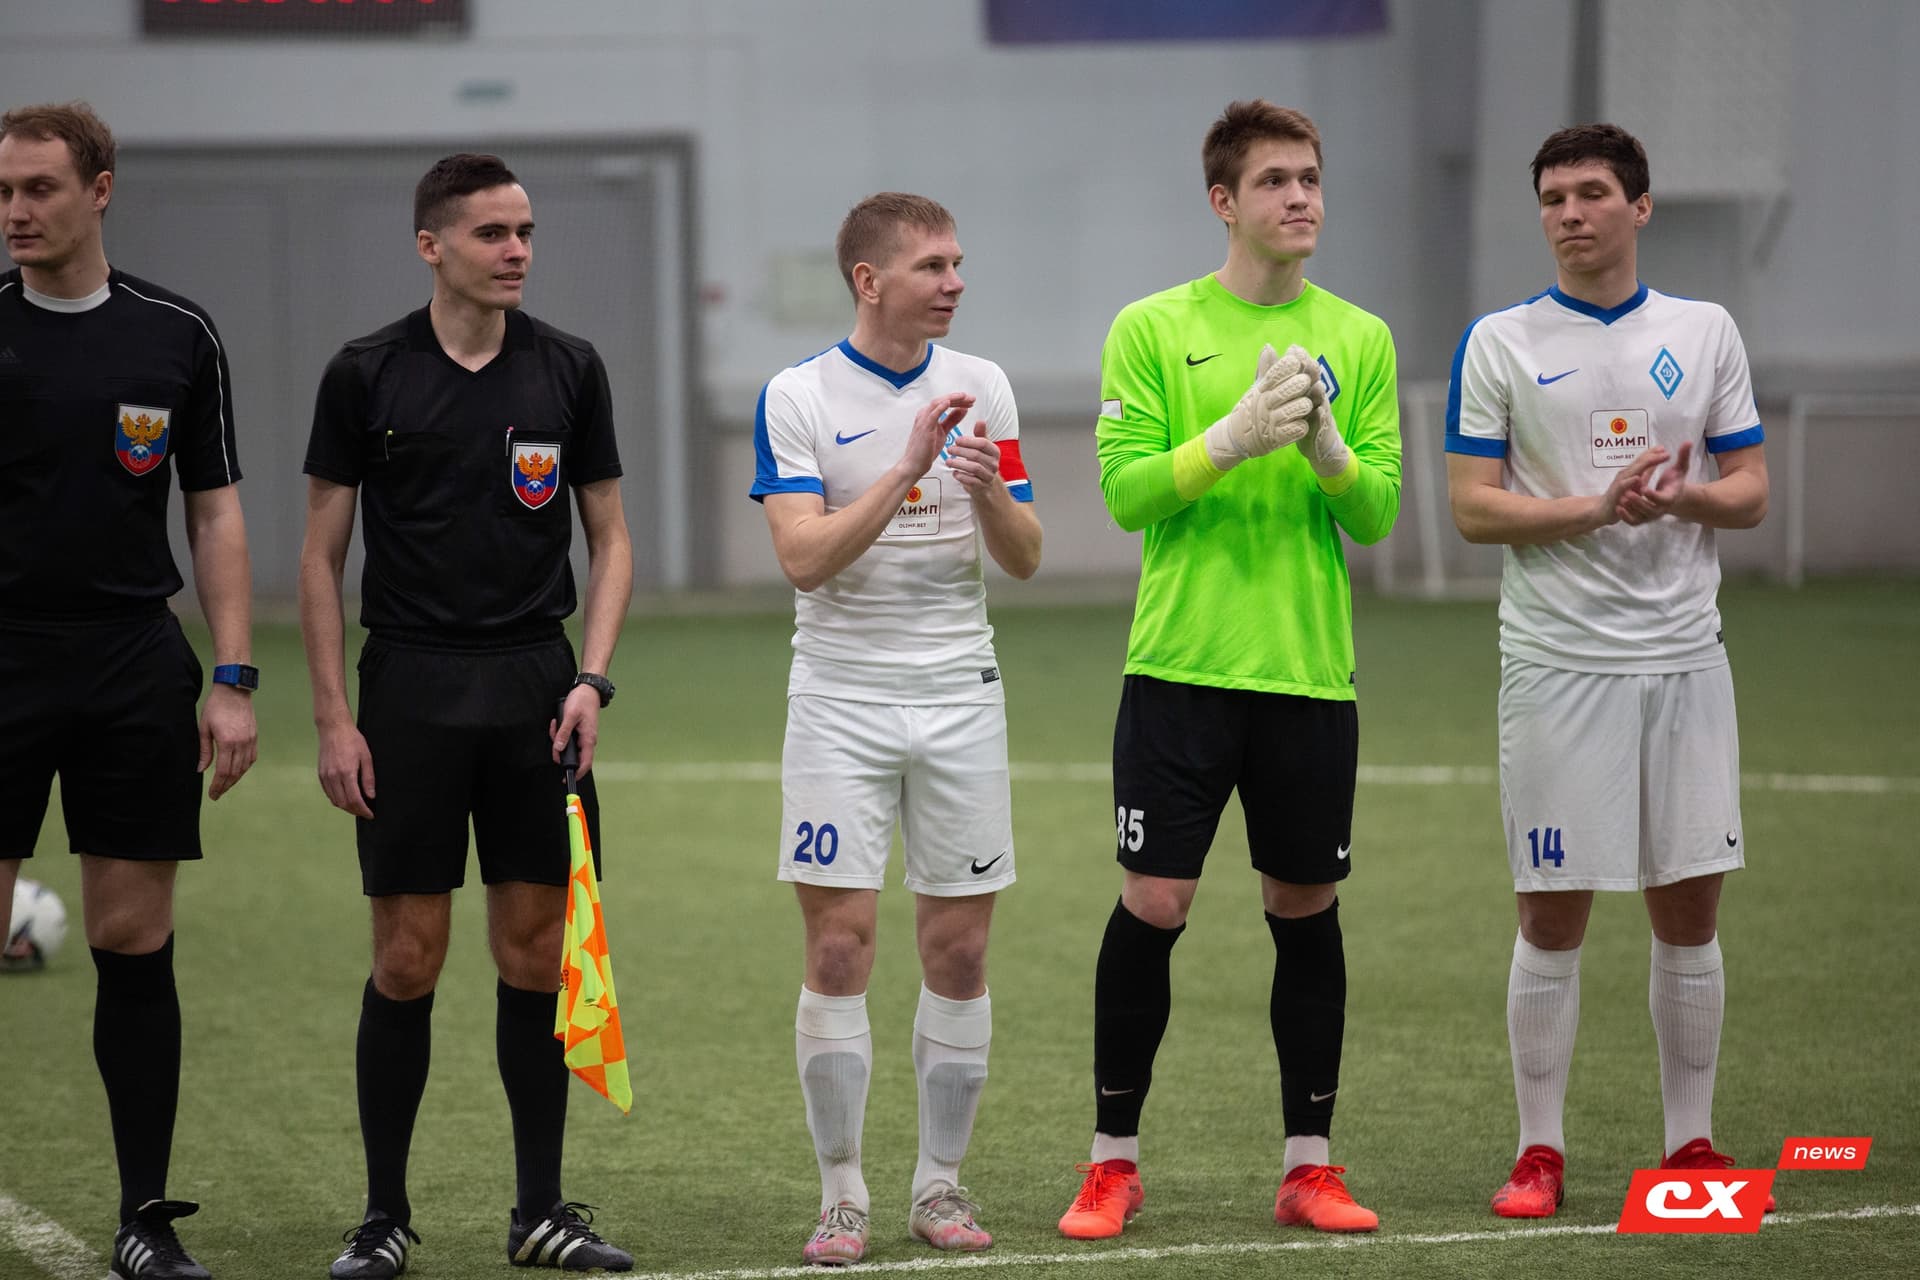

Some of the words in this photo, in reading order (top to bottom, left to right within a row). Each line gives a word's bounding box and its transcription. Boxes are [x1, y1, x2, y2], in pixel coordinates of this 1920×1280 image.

[1594, 436, 1646, 448] ОЛИМП
[897, 505, 938, 515] ЛИМП
[793, 821, 839, 866] 20
[1117, 806, 1145, 852] 85
[1527, 827, 1565, 868] 14
